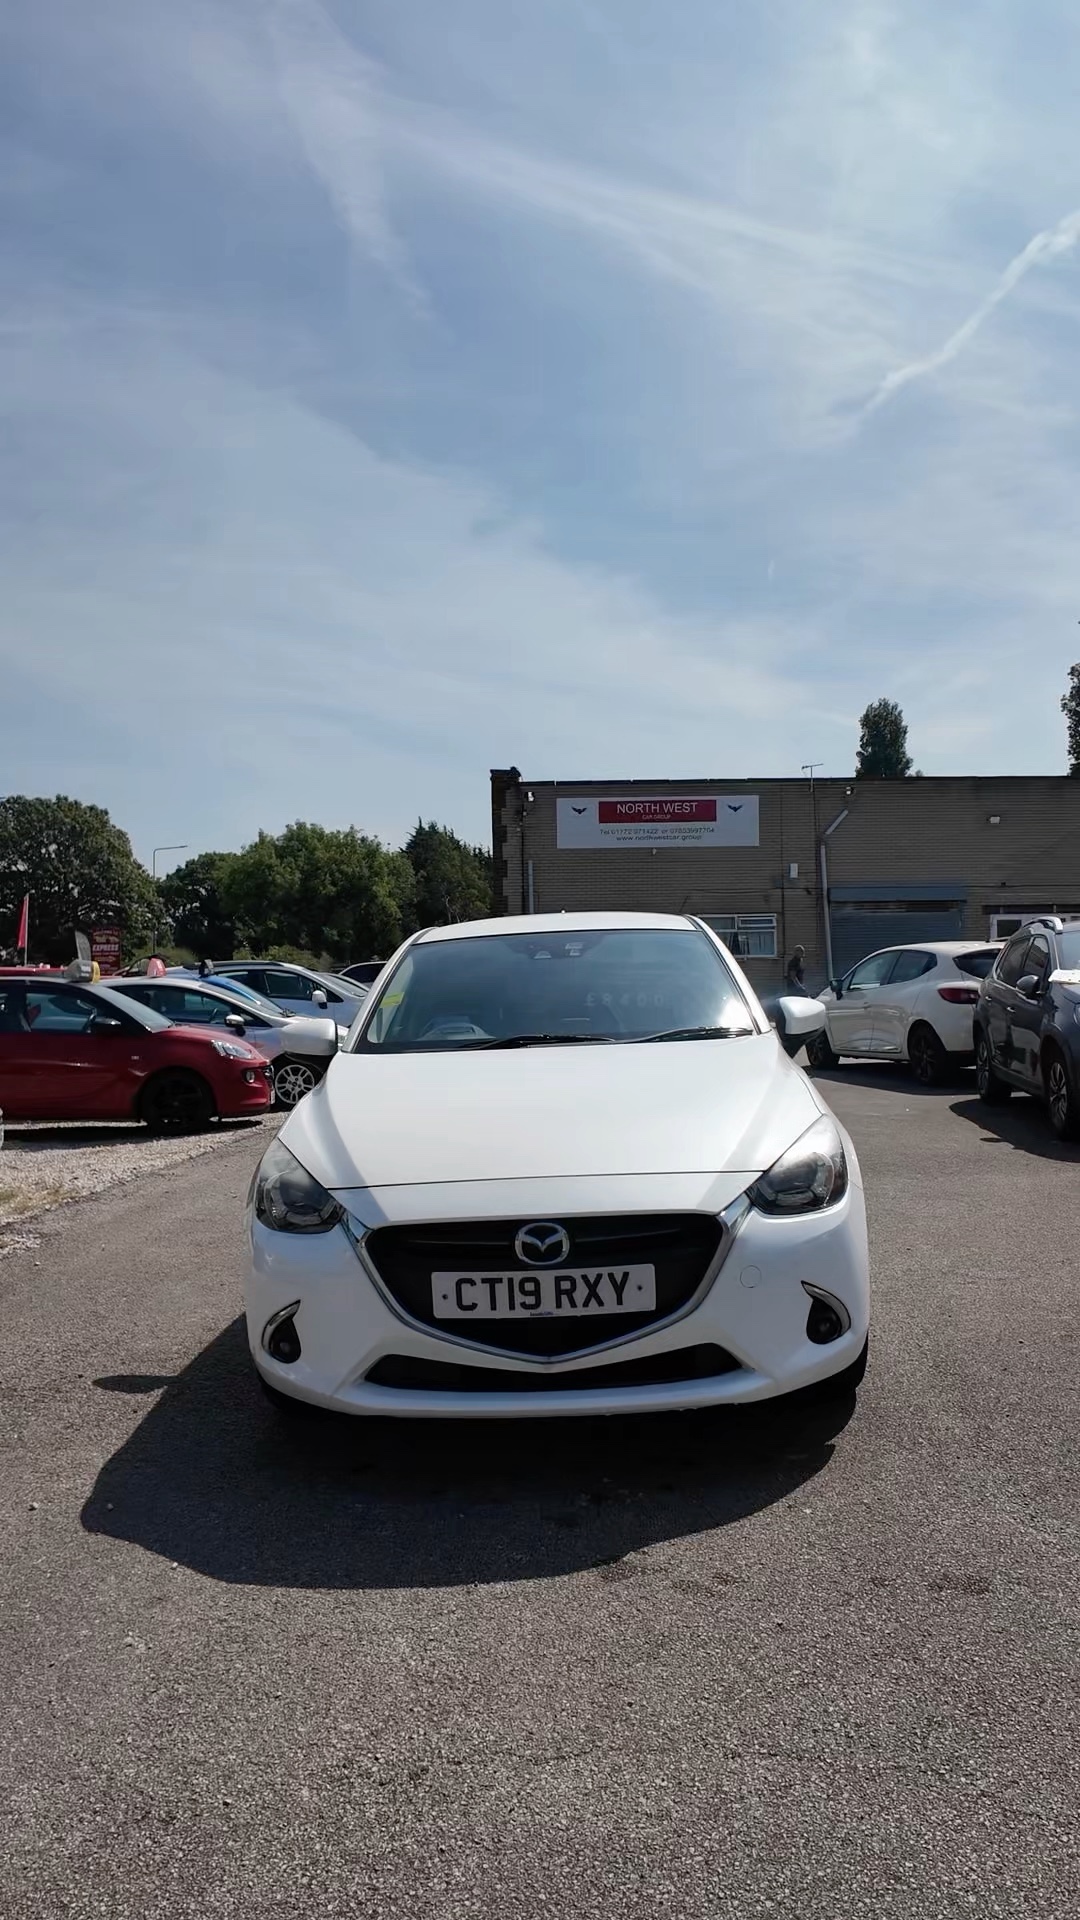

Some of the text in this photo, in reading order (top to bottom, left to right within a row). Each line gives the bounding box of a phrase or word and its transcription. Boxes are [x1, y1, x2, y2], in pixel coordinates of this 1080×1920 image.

[616, 802, 698, 814] NORTH WEST
[455, 1271, 630, 1312] CT19 RXY
